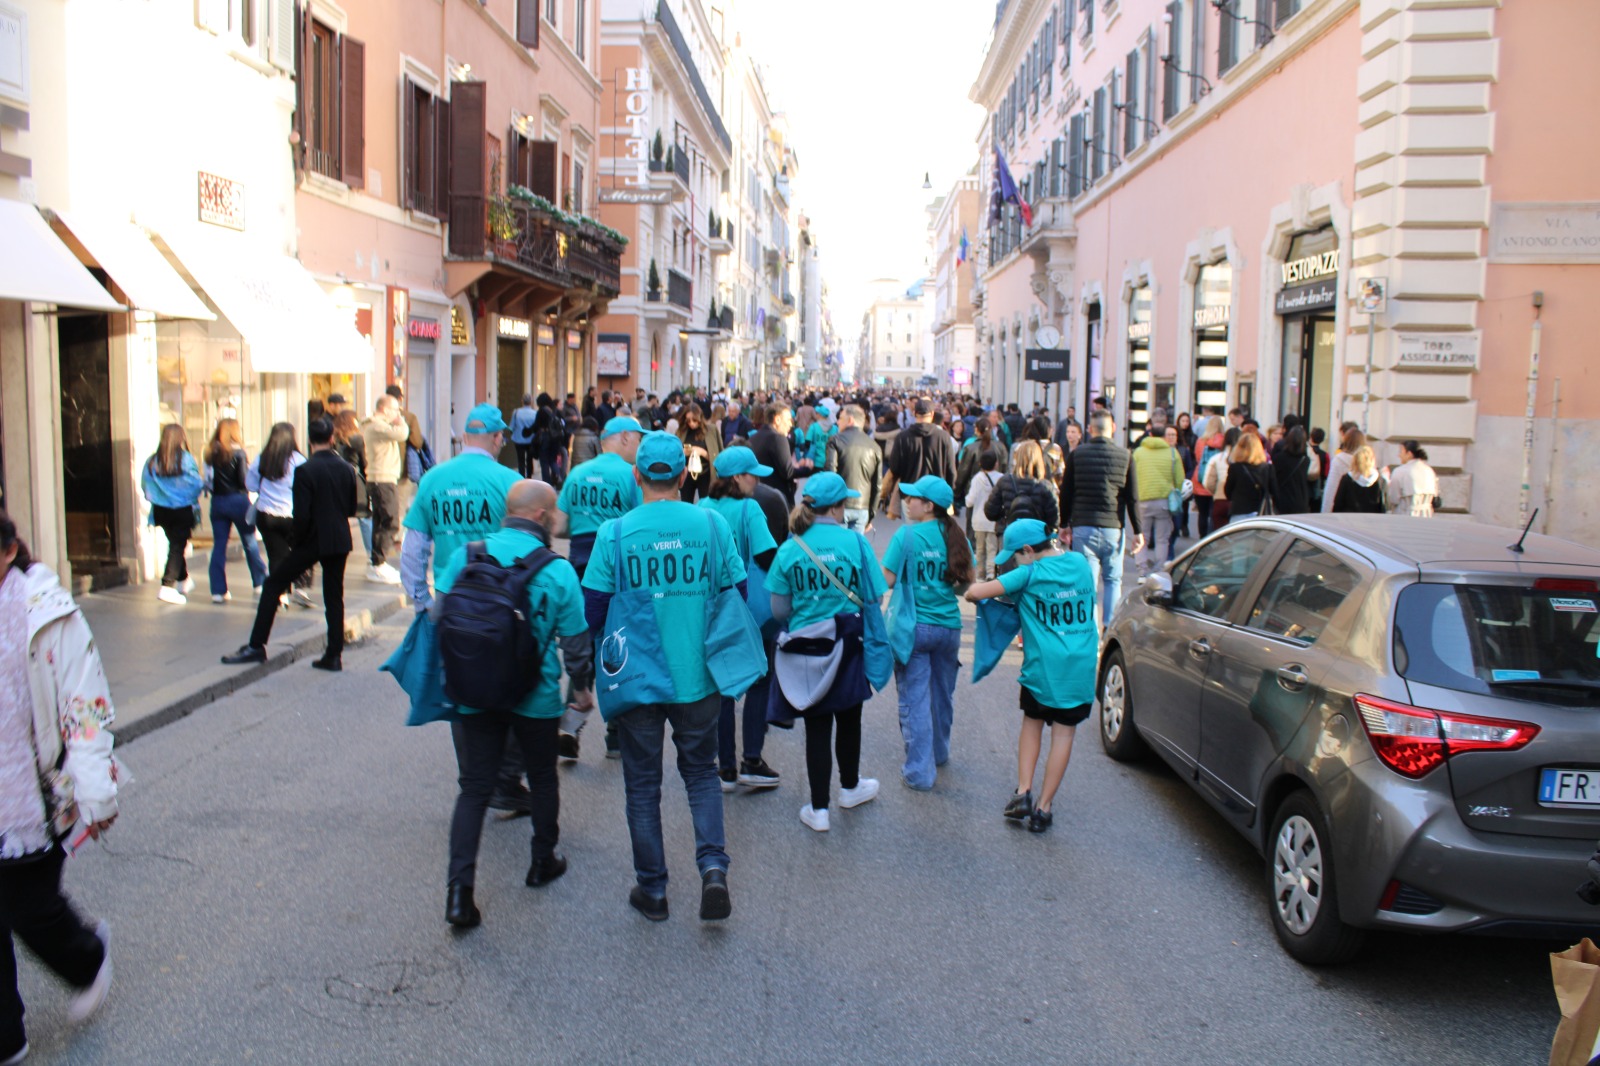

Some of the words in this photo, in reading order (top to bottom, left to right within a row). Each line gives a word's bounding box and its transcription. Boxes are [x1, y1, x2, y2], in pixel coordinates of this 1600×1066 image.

[602, 190, 668, 203] Mozart
[1545, 217, 1571, 229] VIA
[1503, 235, 1559, 248] ANTONIO
[1561, 235, 1600, 248] CANO
[409, 319, 442, 339] CHANGE
[1423, 341, 1453, 351] TORO
[571, 482, 623, 512] DROGA
[431, 497, 492, 526] DROGA
[657, 530, 682, 539] Scopri
[641, 543, 653, 552] LA
[653, 538, 683, 551] VERITÀ
[683, 540, 709, 549] SULLA
[627, 550, 710, 588] DROGA
[794, 565, 859, 591] DROGA
[917, 560, 947, 582] ROG
[1056, 588, 1077, 599] VERITÀ
[1035, 595, 1095, 627] DROG
[1557, 772, 1590, 800] FR
